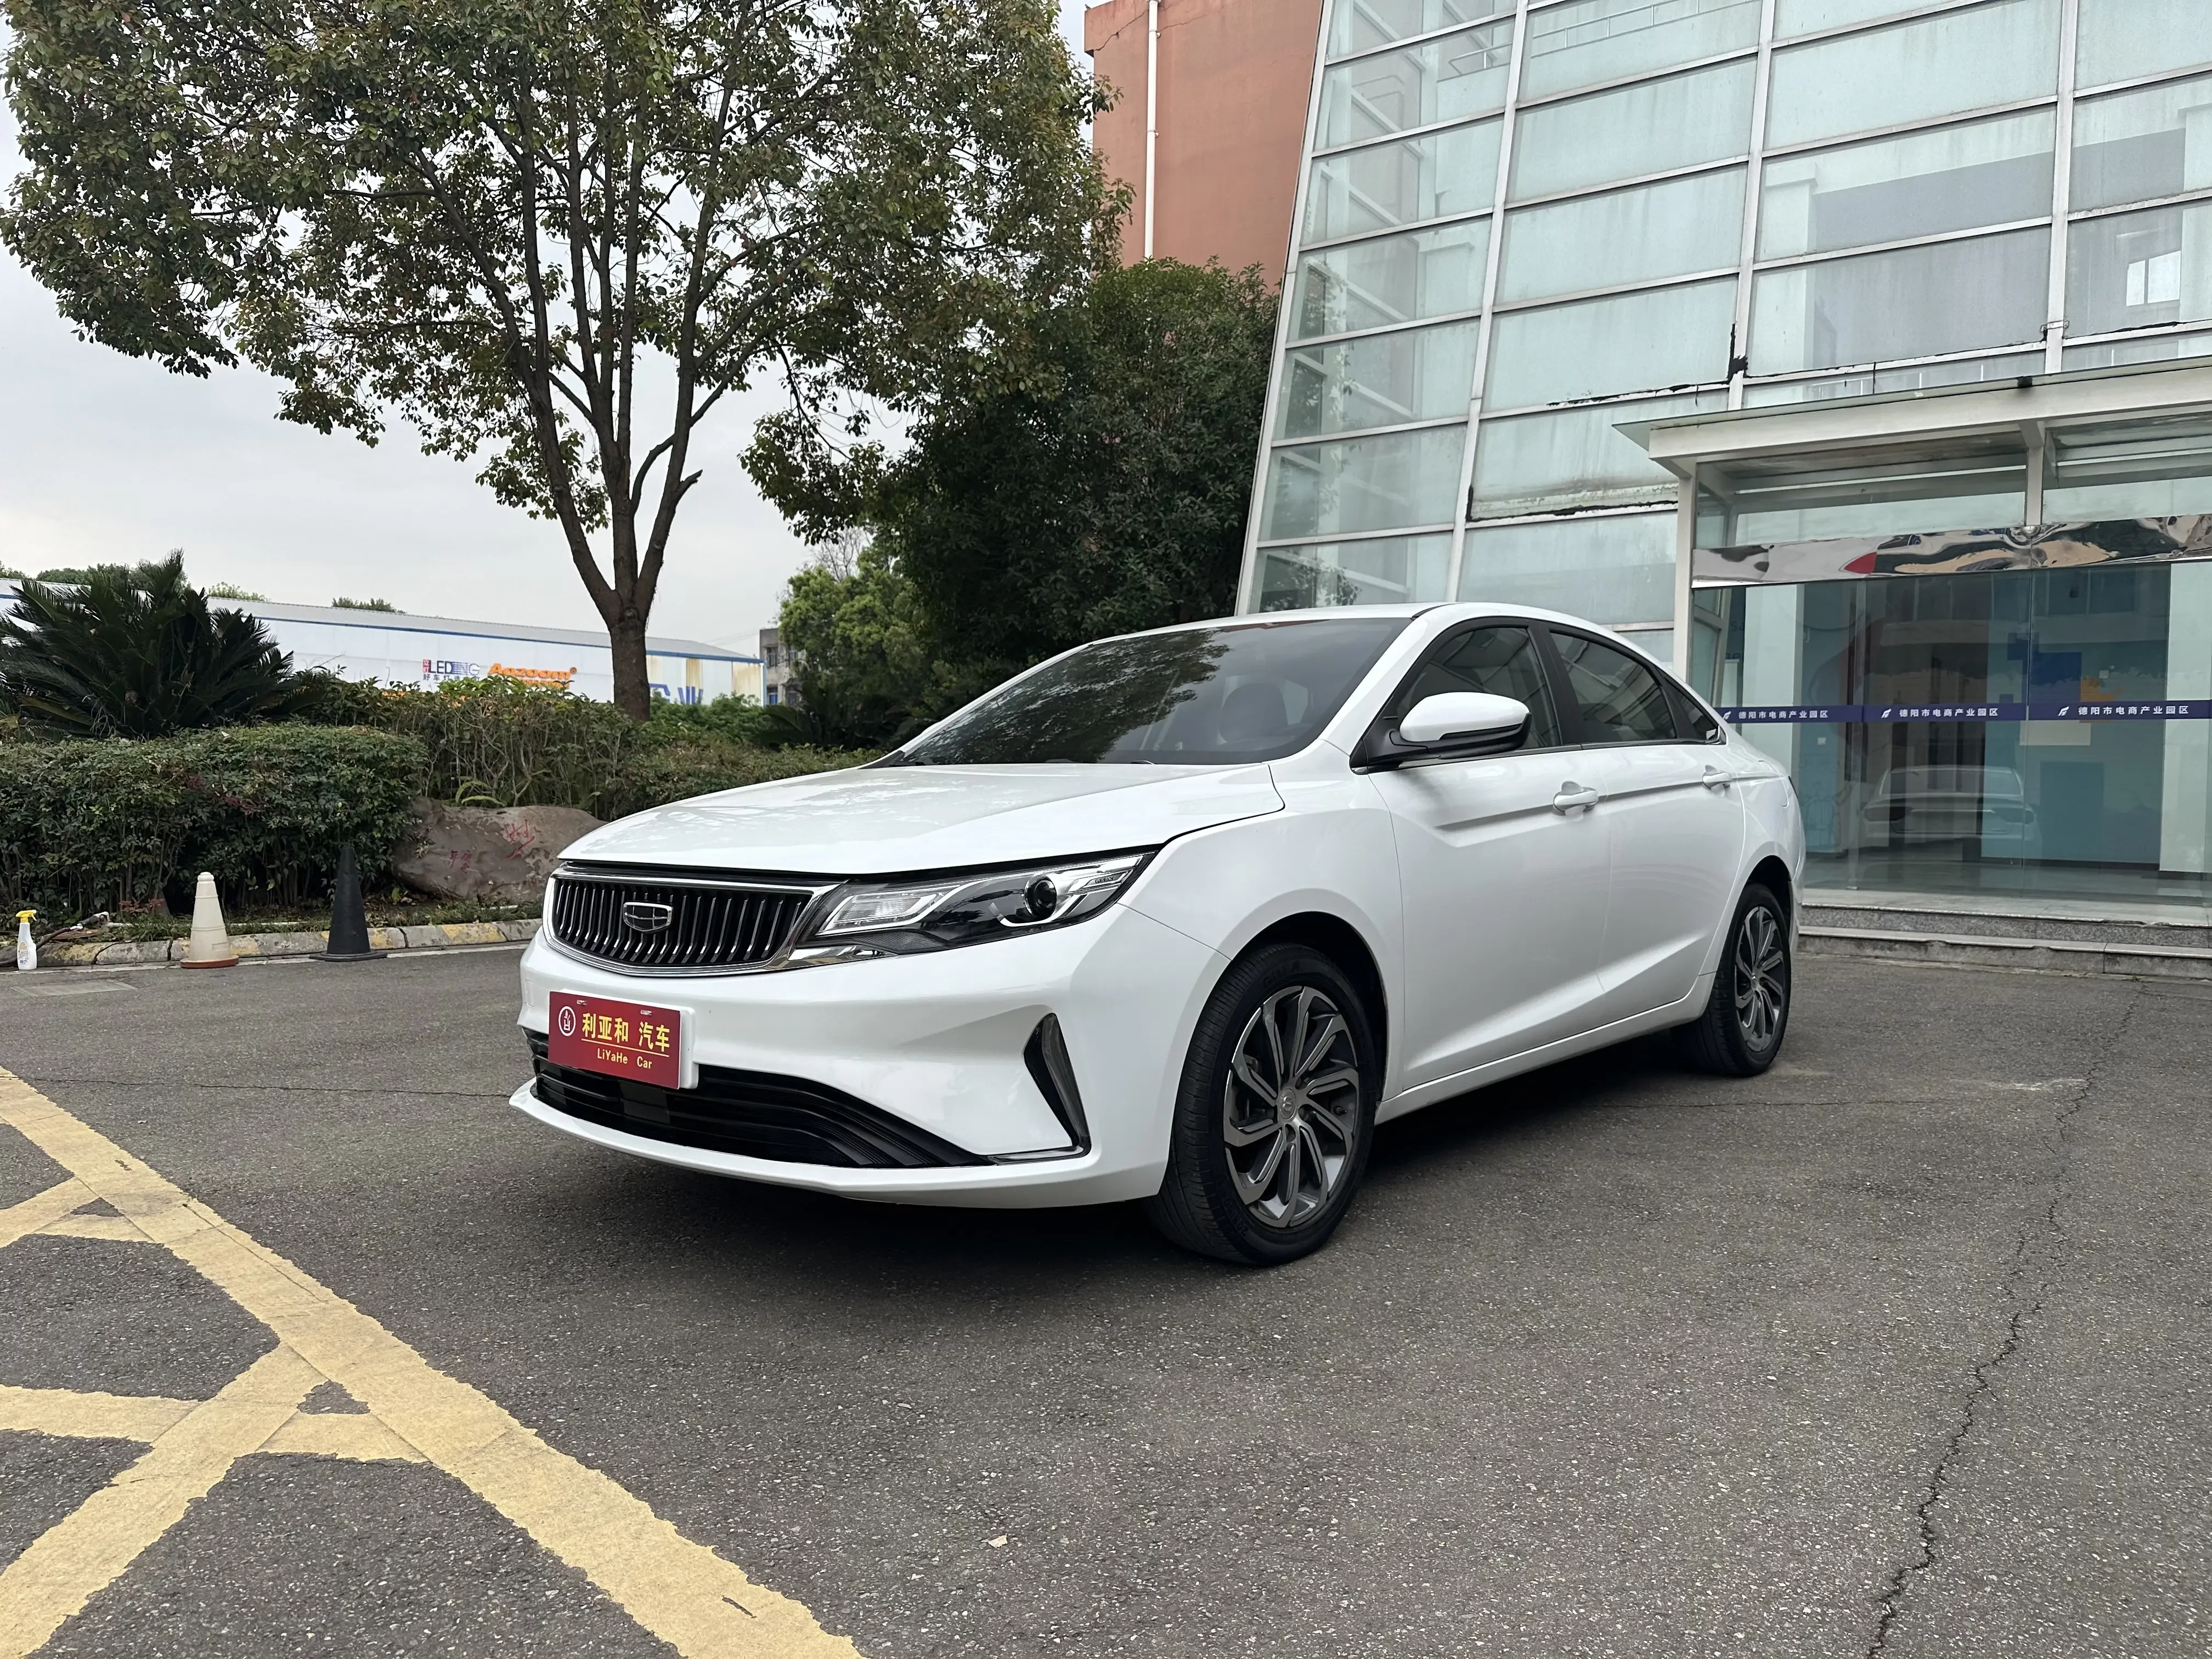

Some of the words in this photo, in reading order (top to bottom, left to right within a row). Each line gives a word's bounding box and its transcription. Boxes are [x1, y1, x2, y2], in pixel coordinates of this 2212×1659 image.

[1739, 710, 1829, 720] 德阳市电商产业园区
[1899, 708, 1999, 718] 德阳市电商产业园区
[2078, 706, 2189, 716] 德阳市电商产业园区
[582, 1012, 629, 1043] 利亚和
[639, 1021, 670, 1052] 汽车
[597, 1048, 628, 1064] LiYaHe
[636, 1056, 652, 1069] Car
